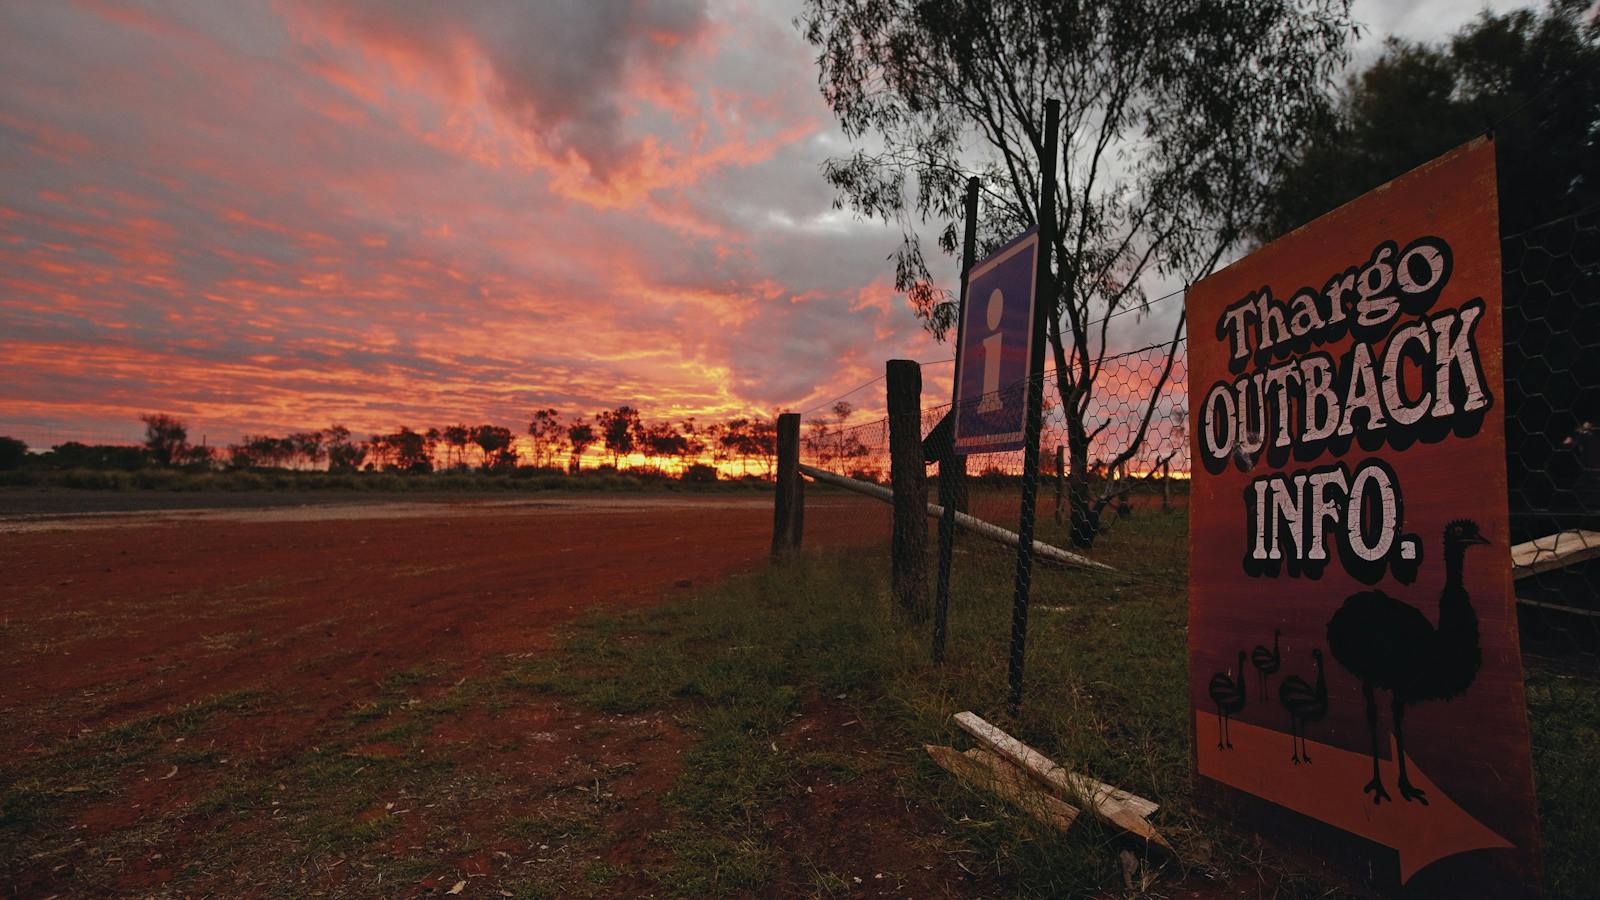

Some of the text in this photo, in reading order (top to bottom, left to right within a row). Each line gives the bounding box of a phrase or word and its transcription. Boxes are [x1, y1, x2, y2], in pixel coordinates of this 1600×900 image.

[1222, 244, 1444, 361] Thargo
[1204, 306, 1489, 460] OUTBACK
[1252, 465, 1417, 562] INFO.
